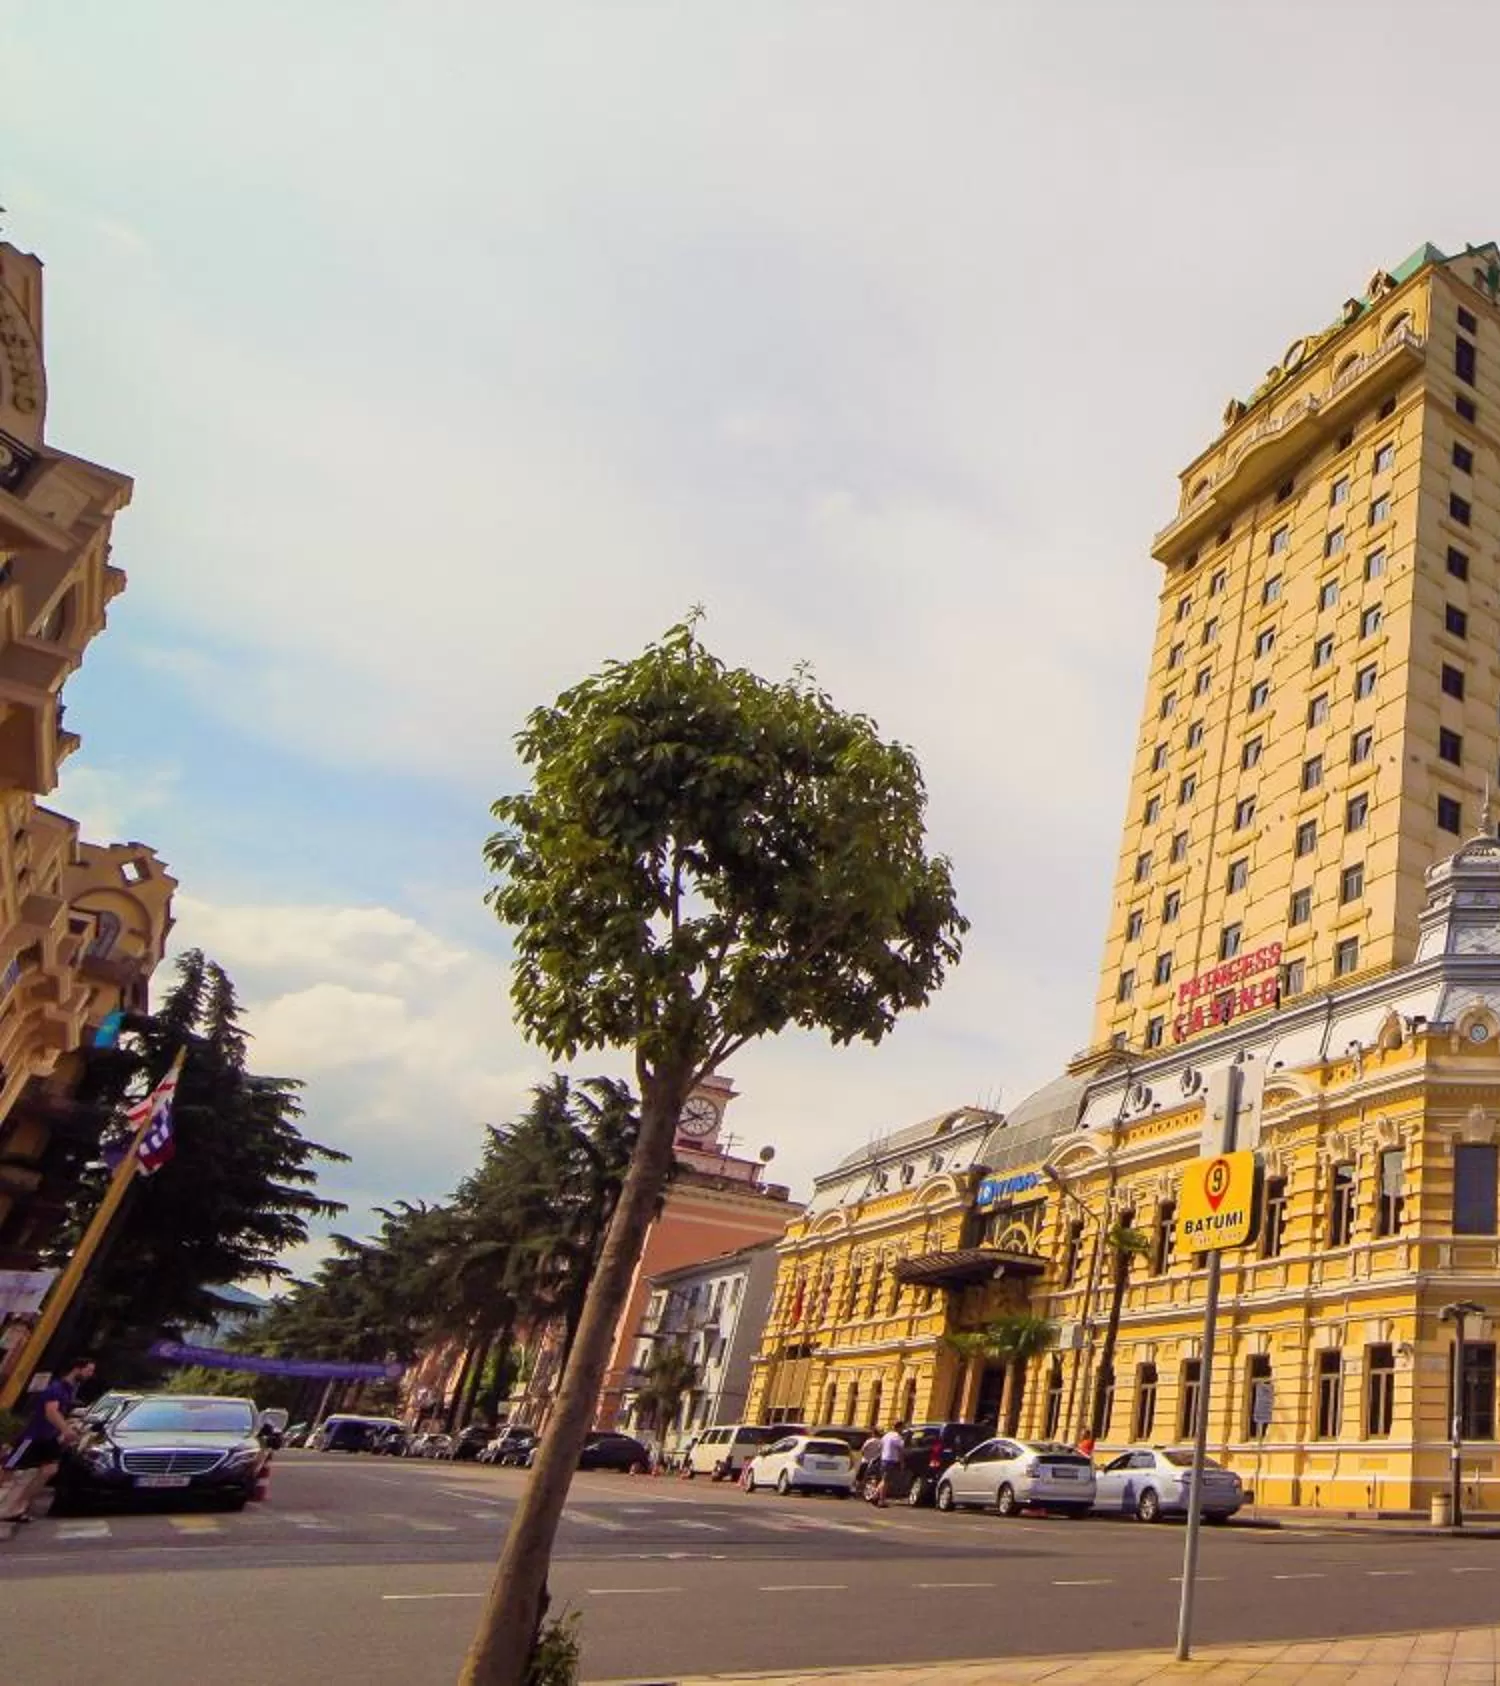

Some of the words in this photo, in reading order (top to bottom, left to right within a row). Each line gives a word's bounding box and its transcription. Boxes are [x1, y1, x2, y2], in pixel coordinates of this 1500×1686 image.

[1178, 941, 1283, 1006] PRINCESS
[1172, 977, 1278, 1044] CASINO
[1183, 1210, 1244, 1235] BATUMI
